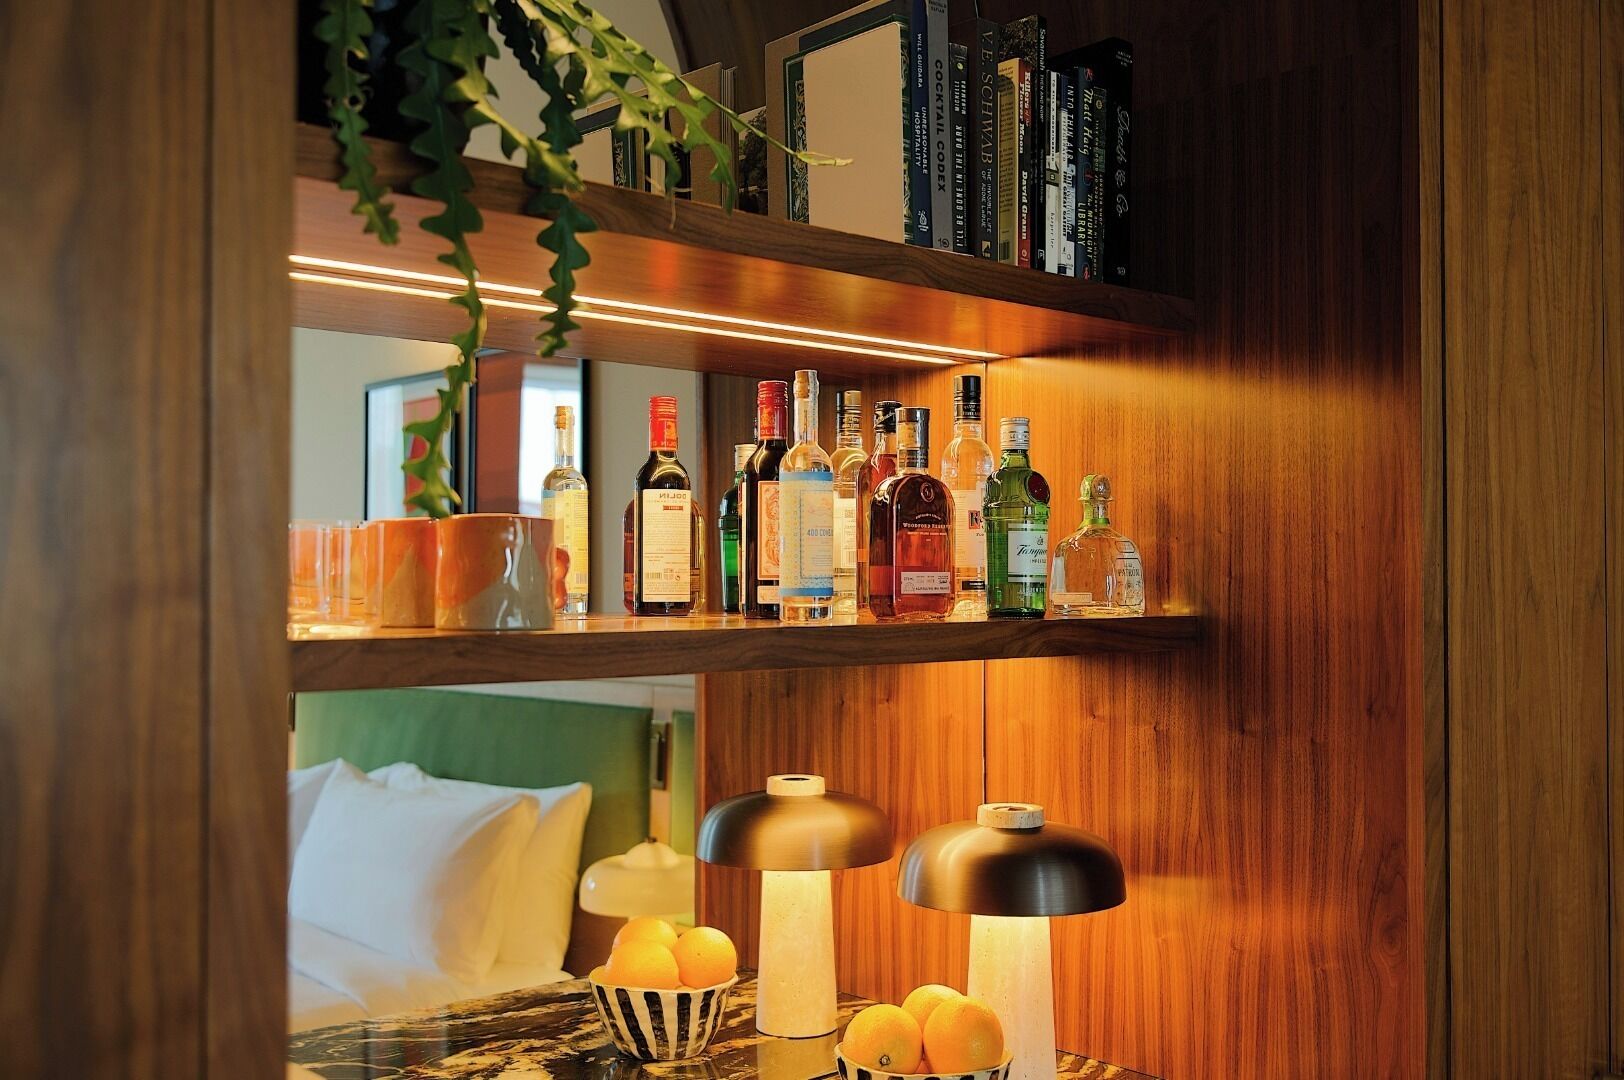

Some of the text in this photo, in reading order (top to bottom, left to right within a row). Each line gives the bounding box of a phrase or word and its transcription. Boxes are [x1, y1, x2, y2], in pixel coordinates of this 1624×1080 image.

[981, 30, 993, 164] V. E. SCHWAB
[1078, 88, 1094, 155] Matt Haig
[935, 59, 946, 193] COCKTAIL CODEX
[1116, 105, 1130, 163] Death
[956, 174, 962, 184] IN
[1115, 169, 1127, 188] &
[956, 214, 963, 226] BE
[1078, 202, 1086, 246] LIBRARY
